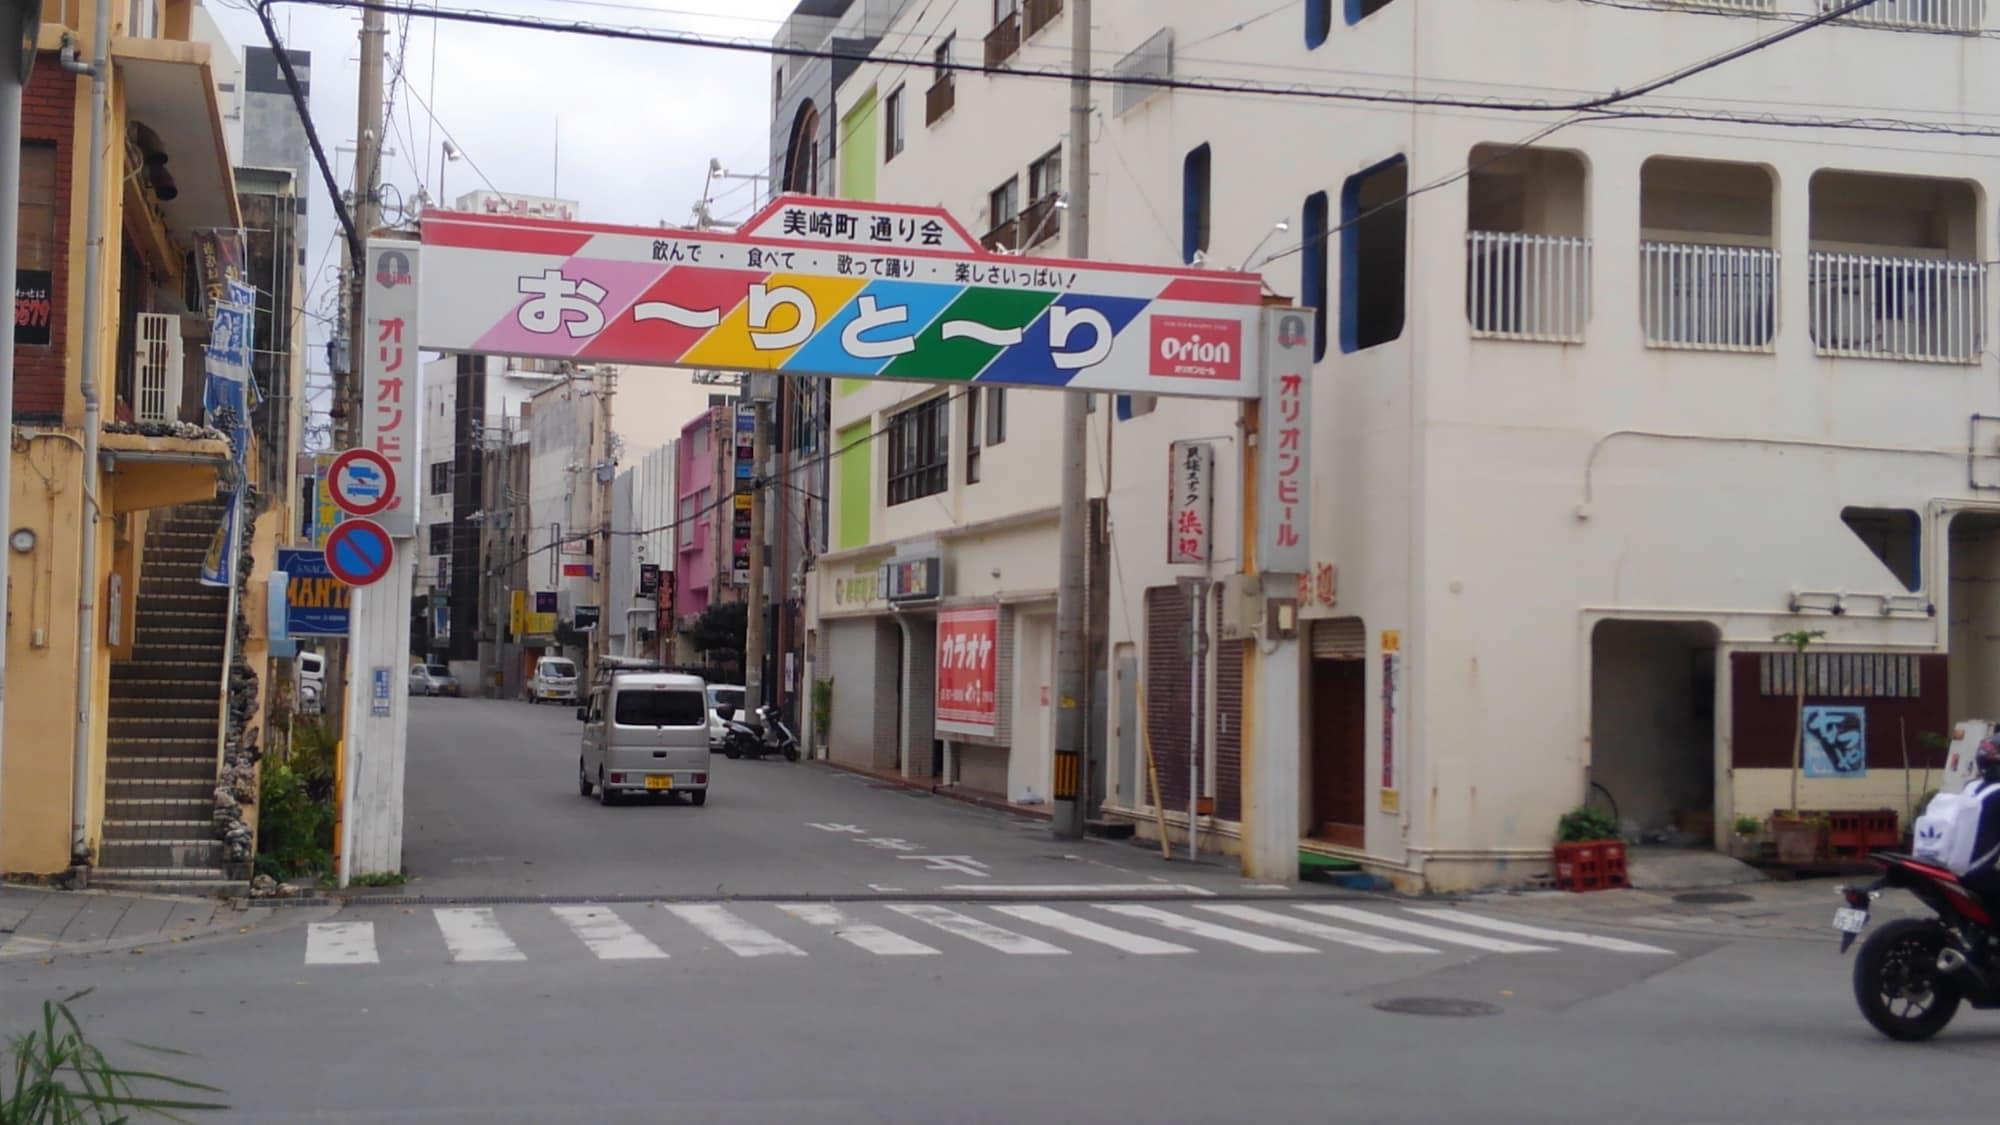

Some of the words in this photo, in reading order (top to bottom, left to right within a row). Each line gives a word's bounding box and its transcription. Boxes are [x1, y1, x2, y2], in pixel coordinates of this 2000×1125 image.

[783, 209, 858, 240] 美崎町
[870, 216, 943, 246] 通り会
[652, 240, 701, 263] 飲んで
[747, 248, 795, 270] 食べて
[837, 254, 915, 278] 歌って踊り
[955, 262, 1077, 290] 楽しさいっぱい！
[1161, 333, 1231, 364] Orion
[377, 317, 405, 510] オリオンビ
[1276, 373, 1303, 547] オリオンビール
[943, 633, 992, 670] カラオケ
